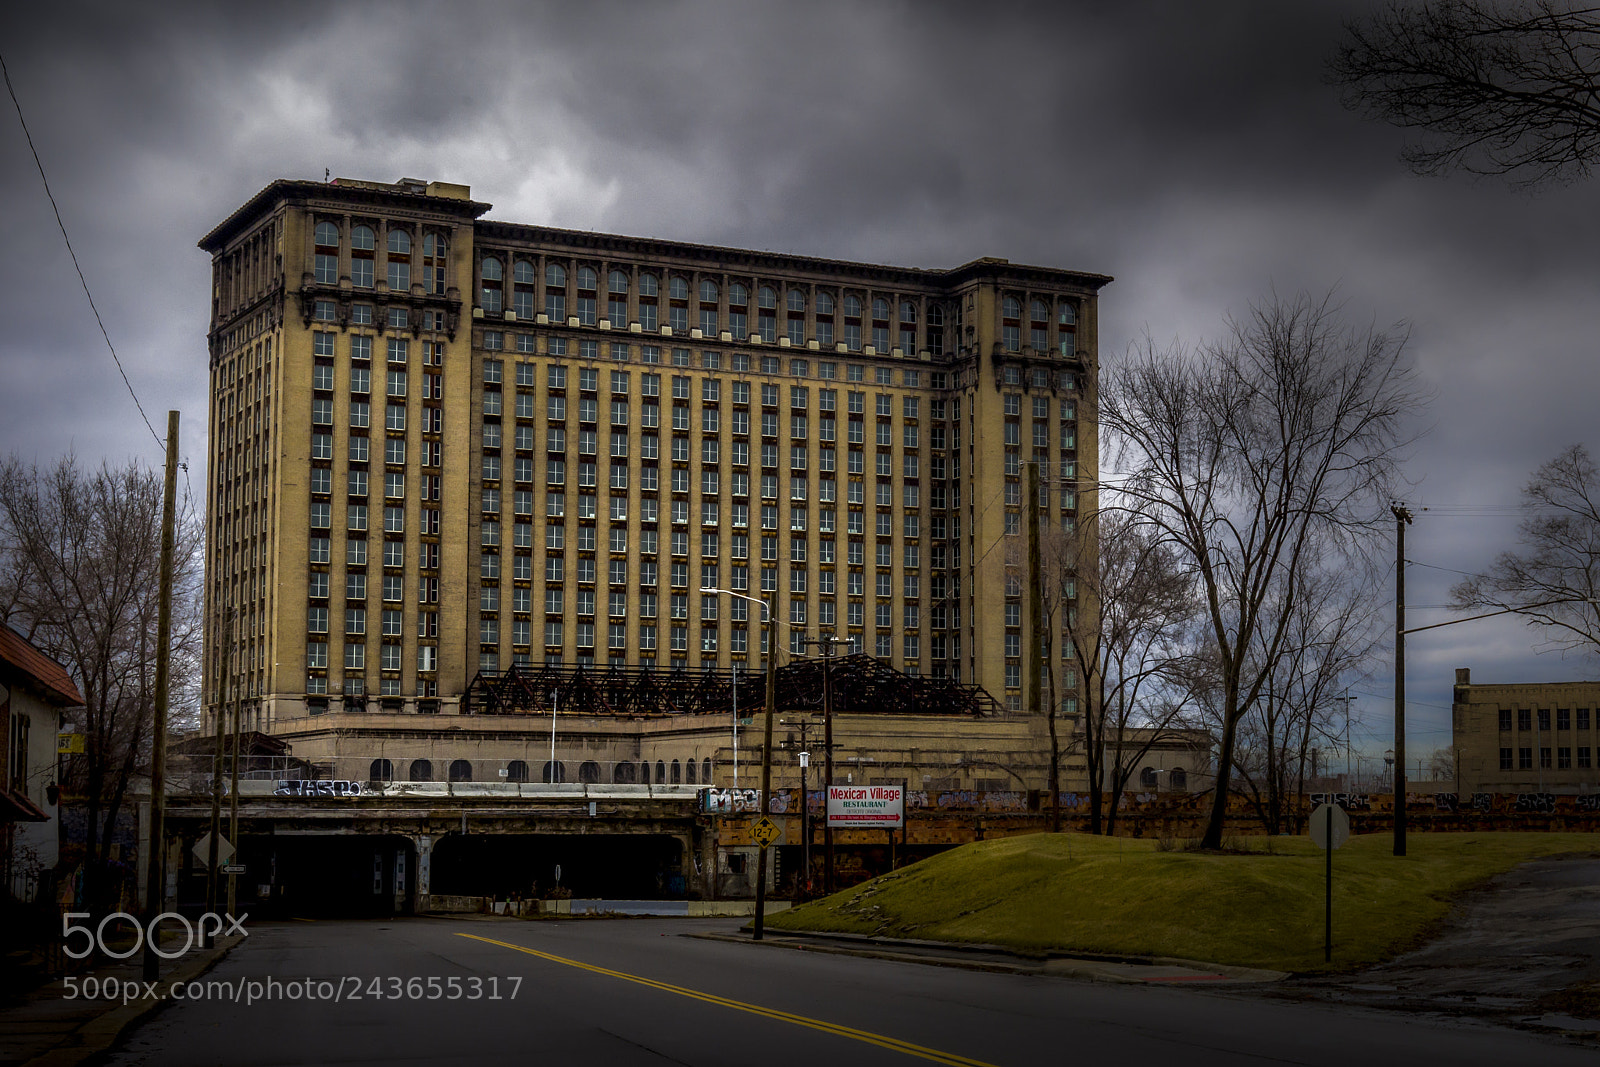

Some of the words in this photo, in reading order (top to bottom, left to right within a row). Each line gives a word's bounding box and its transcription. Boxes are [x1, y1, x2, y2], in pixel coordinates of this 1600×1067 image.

[830, 788, 867, 799] Mexican
[870, 787, 900, 801] Village
[754, 828, 772, 837] 12-7
